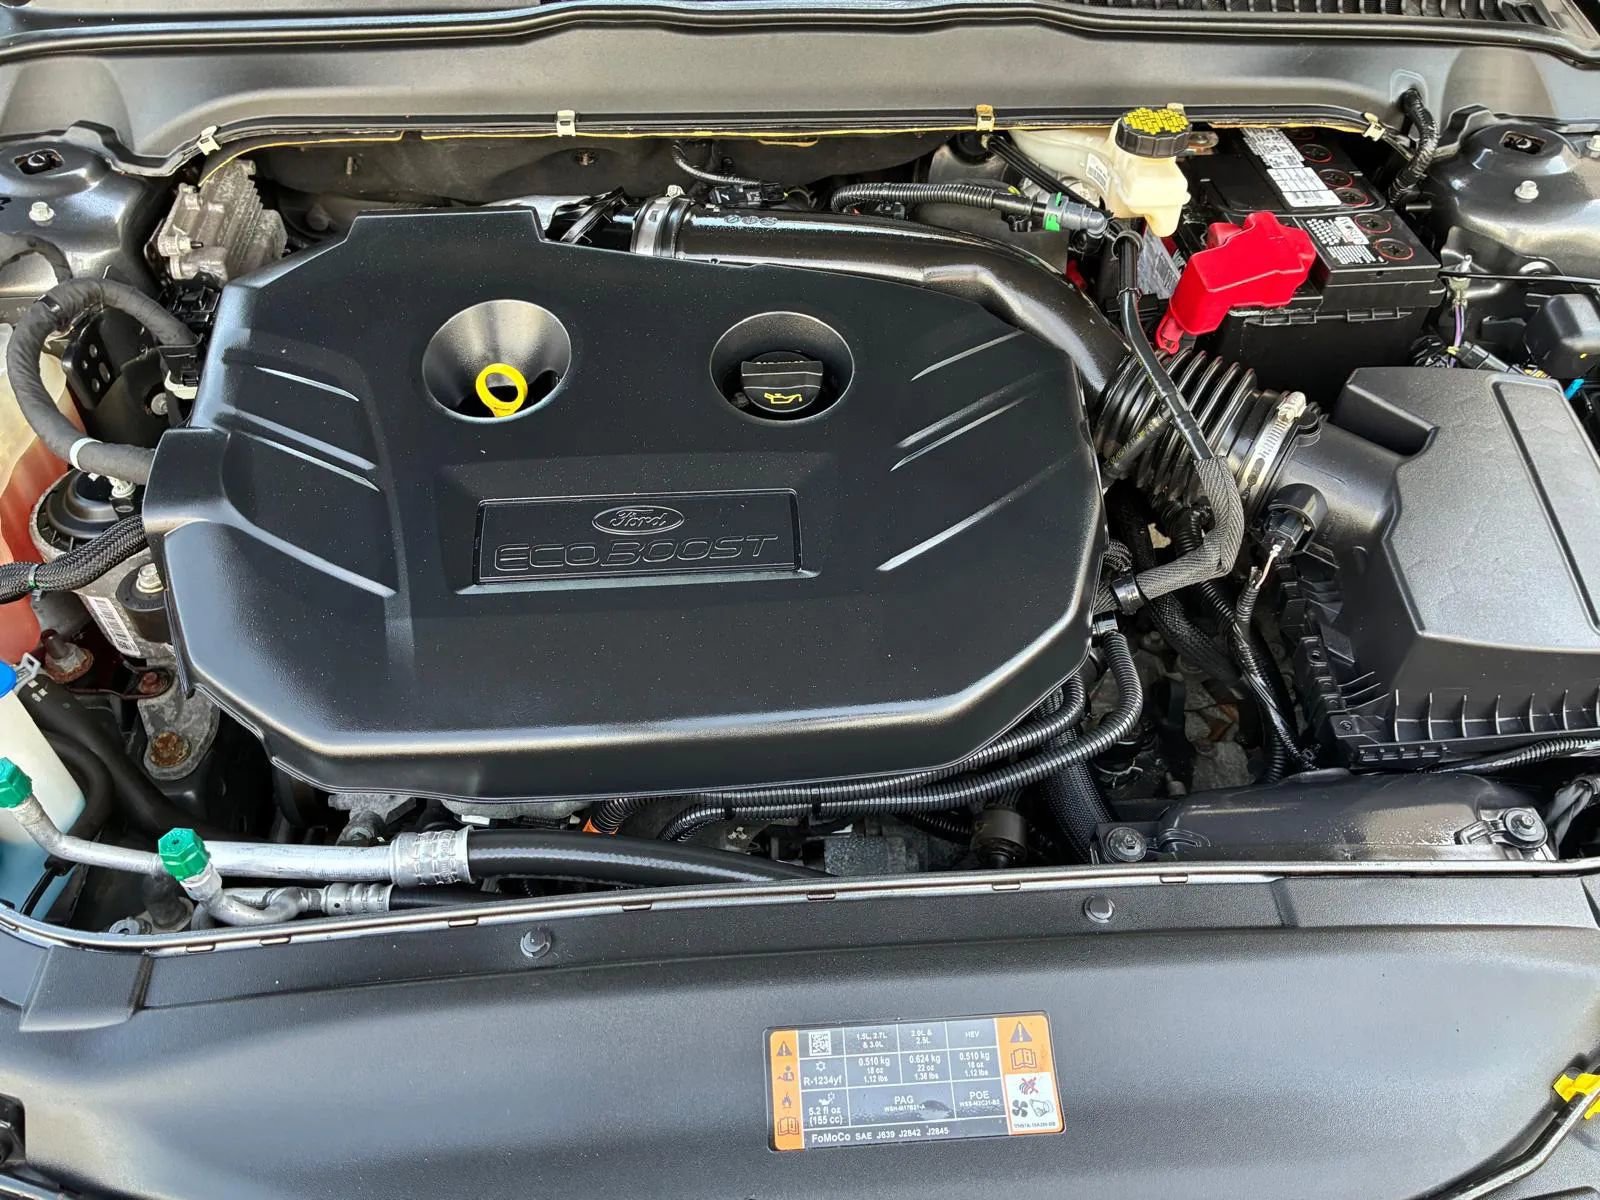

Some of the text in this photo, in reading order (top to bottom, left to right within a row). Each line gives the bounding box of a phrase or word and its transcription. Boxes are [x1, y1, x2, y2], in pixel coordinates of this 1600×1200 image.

[609, 508, 668, 529] Ford
[494, 534, 779, 572] ECOBOOST
[858, 1056, 890, 1066] 0.510 kg
[908, 1053, 941, 1064] 0.624 kg
[959, 1051, 990, 1061] 0.510 kg
[917, 1064, 925, 1072] 22
[978, 1069, 989, 1077] lbs
[803, 1075, 842, 1086] R-1234yf
[863, 1074, 889, 1083] 1.12 lbs
[928, 1072, 939, 1080] lbs
[894, 1095, 914, 1104] PAG
[968, 1090, 990, 1099] POE
[808, 1106, 841, 1115] 5.2 fl oz
[809, 1115, 844, 1126] (155 cc)
[811, 1126, 949, 1143] FoMoCo SAE J639 J2842 J2845
